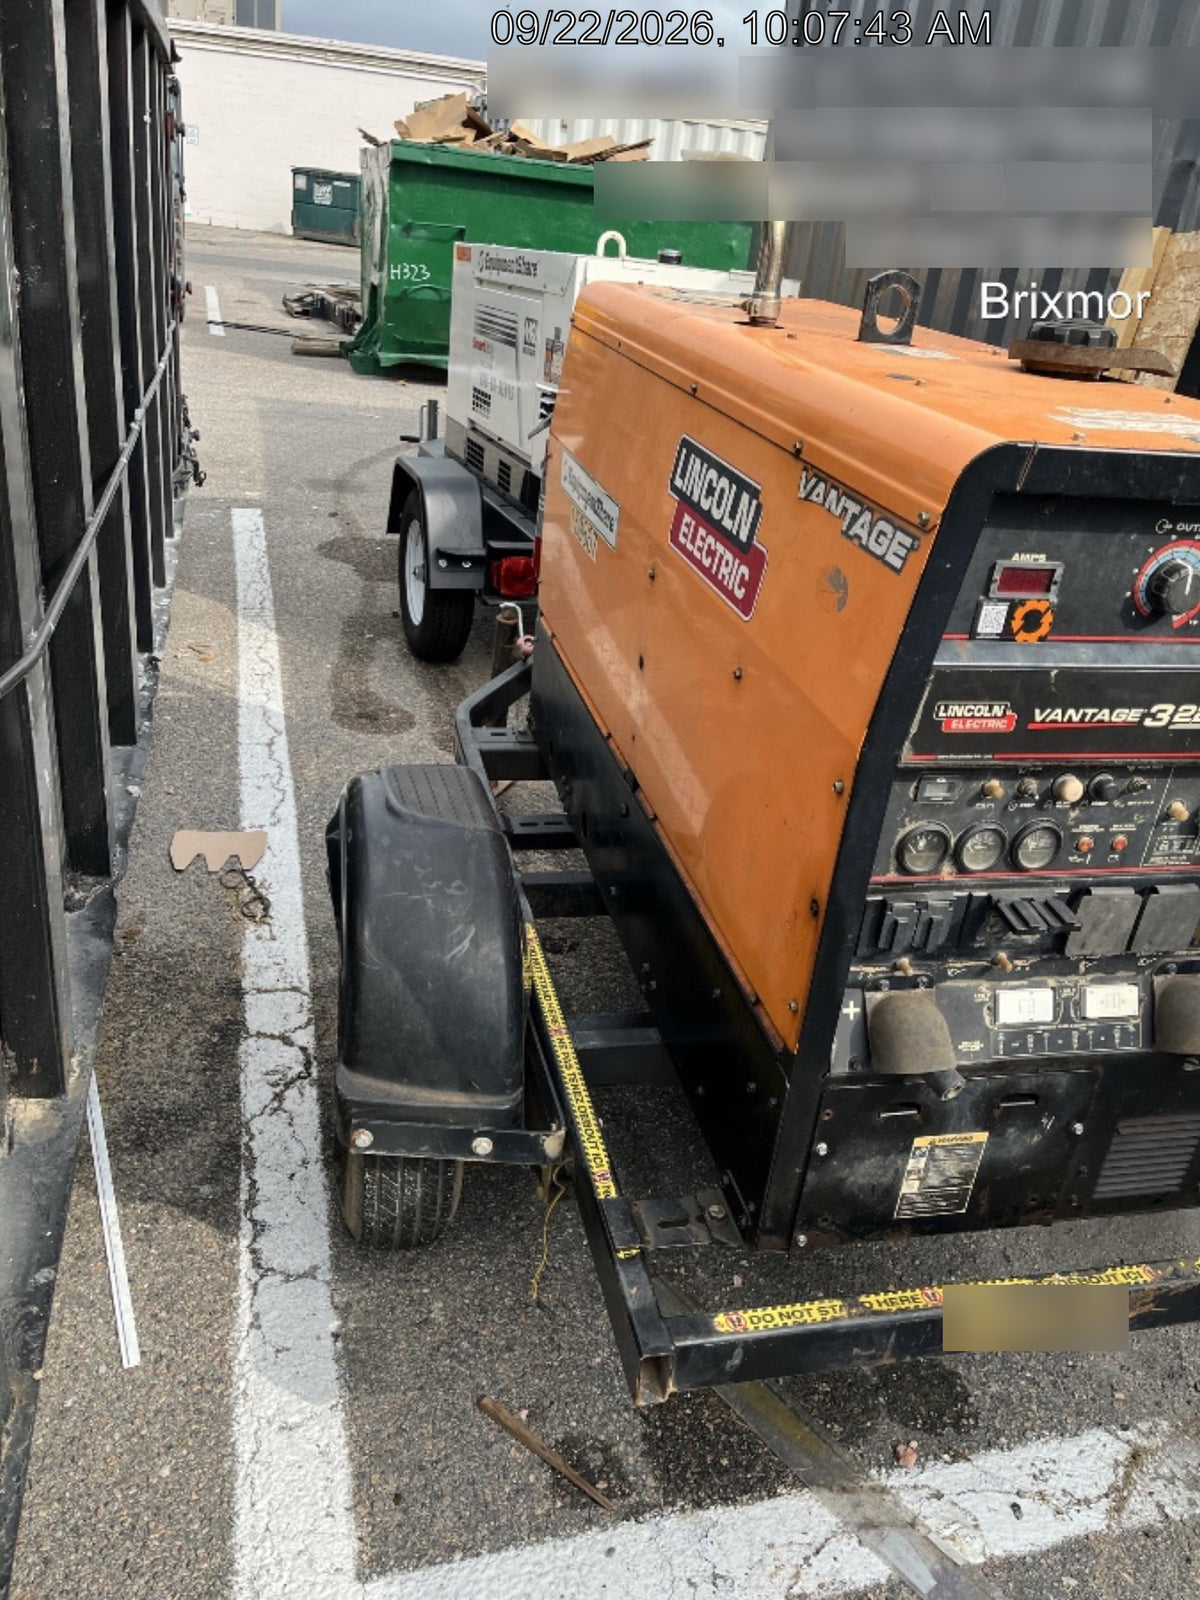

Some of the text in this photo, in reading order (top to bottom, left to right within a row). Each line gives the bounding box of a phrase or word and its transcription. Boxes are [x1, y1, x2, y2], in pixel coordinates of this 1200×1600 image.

[390, 263, 431, 281] H323
[674, 448, 758, 543] LINCOLN
[798, 470, 913, 570] VANTAGE
[1176, 522, 1200, 532] OUT
[678, 512, 750, 600] ELECTRIC
[1011, 553, 1047, 562] AMPS
[938, 704, 1006, 717] LINCOLN
[1034, 703, 1200, 727] VANTAGE 32
[951, 719, 1008, 730] ELECTRIC
[1122, 1270, 1145, 1282] ICI
[750, 1311, 776, 1326] DO
[779, 1306, 813, 1322] NOT
[876, 1294, 922, 1308] HERE
